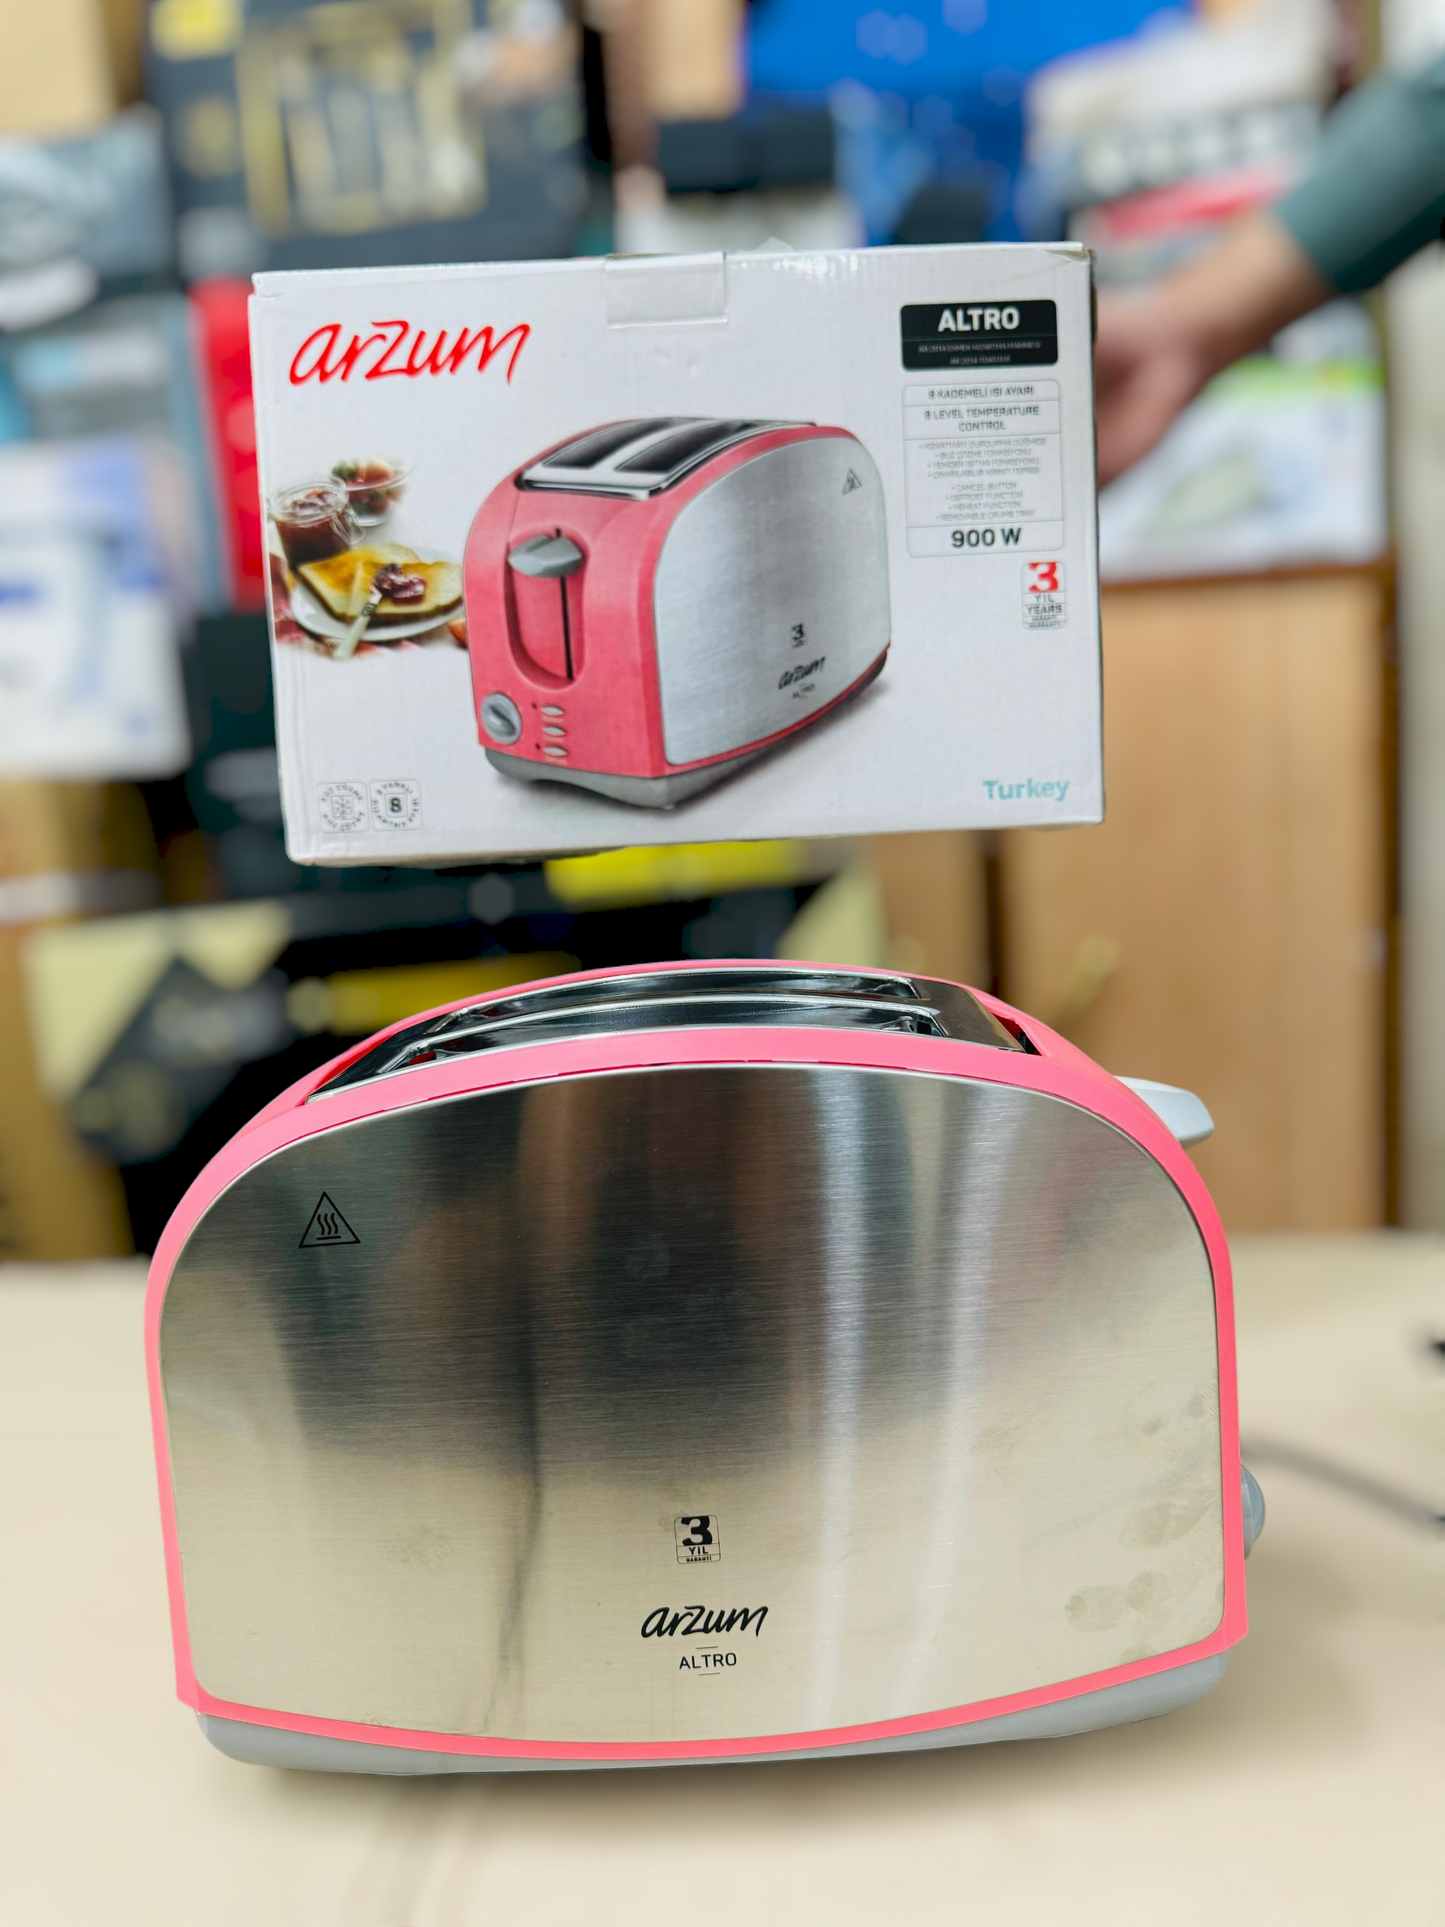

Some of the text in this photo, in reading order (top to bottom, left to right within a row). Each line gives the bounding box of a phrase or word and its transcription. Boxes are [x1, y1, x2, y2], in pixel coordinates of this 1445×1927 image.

[937, 306, 1020, 333] ALTRO
[289, 320, 531, 386] arzum
[1005, 385, 1034, 396] AYARI
[924, 406, 1040, 420] 8 LEVEL TEMPERATURE
[958, 420, 1006, 432] CONTROL
[951, 527, 1022, 548] 900 W
[1027, 561, 1060, 593] 3
[1027, 603, 1062, 615] YEARS
[791, 623, 804, 640] 3
[982, 777, 1071, 803] Turkey
[390, 797, 402, 813] 8
[681, 1515, 713, 1546] 3
[689, 1546, 708, 1555] YIL
[641, 1605, 769, 1638] arzum
[679, 1652, 737, 1669] ALTRO
